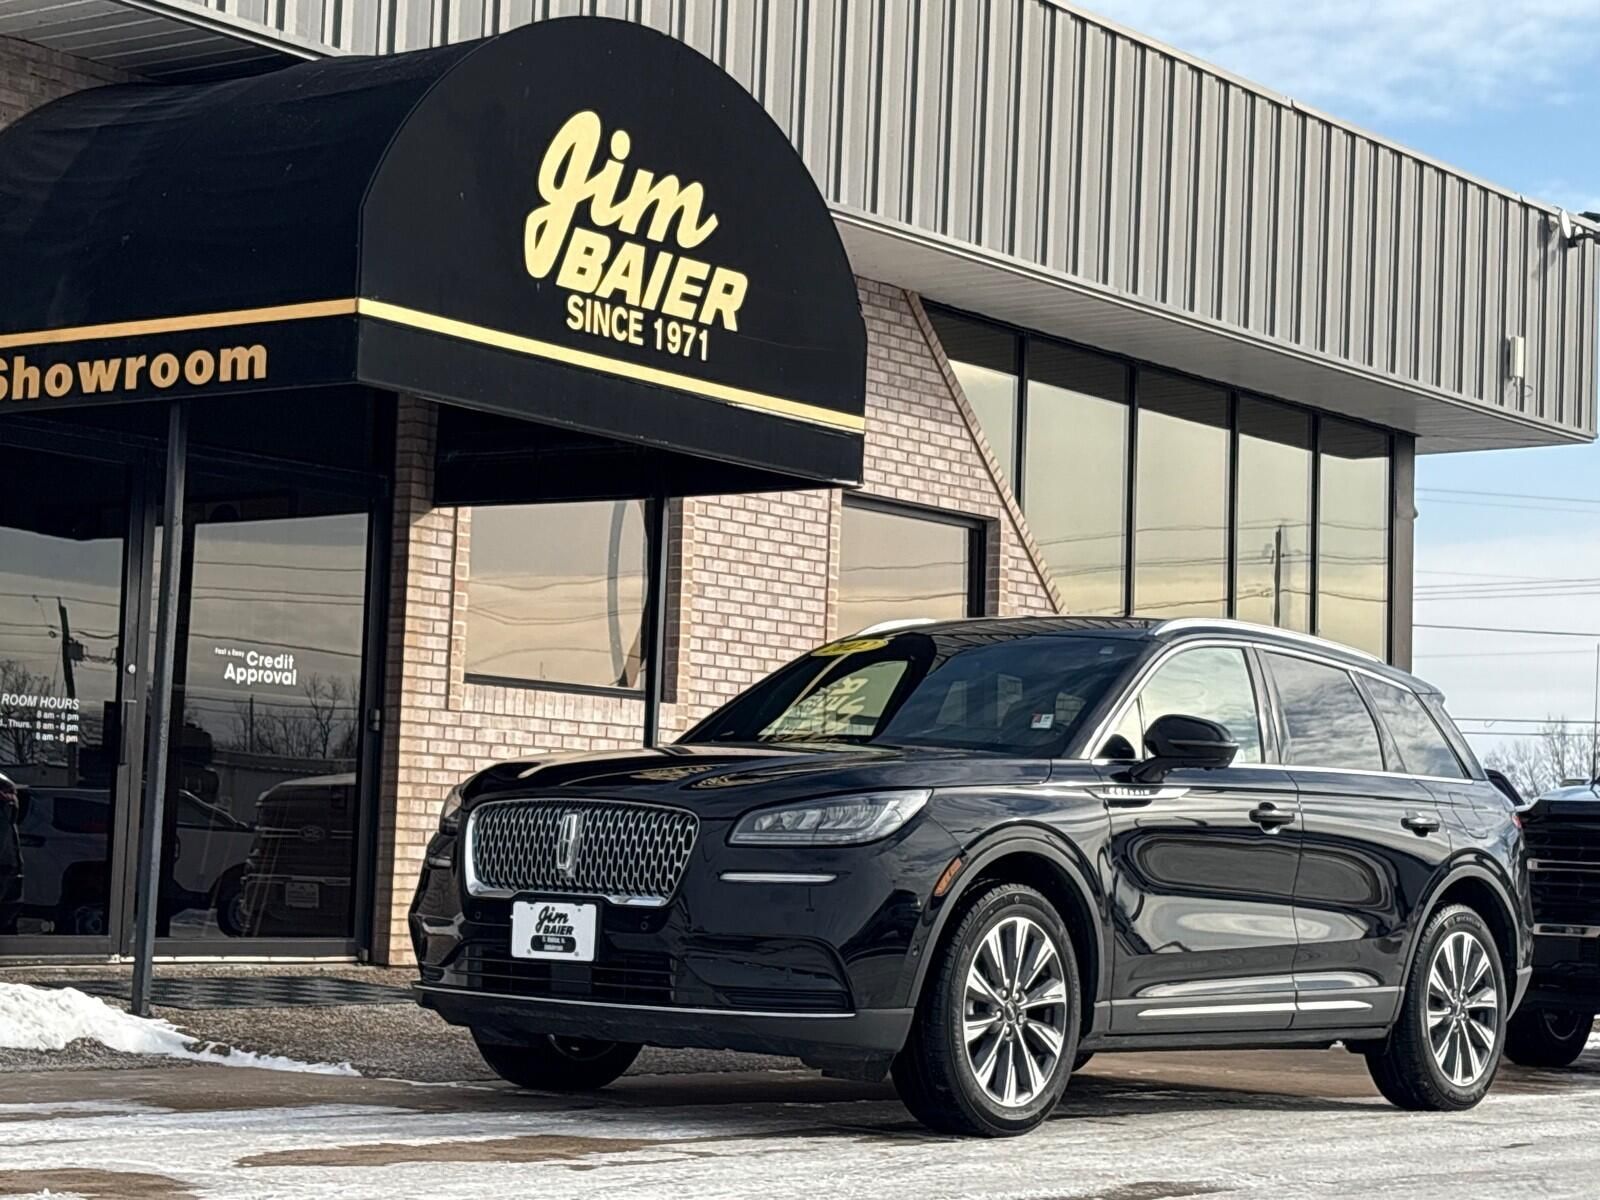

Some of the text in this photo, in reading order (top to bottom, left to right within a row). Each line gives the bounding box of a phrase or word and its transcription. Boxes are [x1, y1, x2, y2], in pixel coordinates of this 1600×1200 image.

[524, 111, 719, 279] Jim
[555, 227, 748, 332] BAIER
[566, 295, 708, 361] SINCE 1971
[246, 651, 294, 669] Credit
[224, 663, 297, 685] Approval
[40, 696, 79, 709] HOURS
[8, 718, 32, 729] Thurs.
[66, 735, 78, 744] pm
[535, 905, 569, 934] Jim
[543, 924, 574, 935] BAIER
